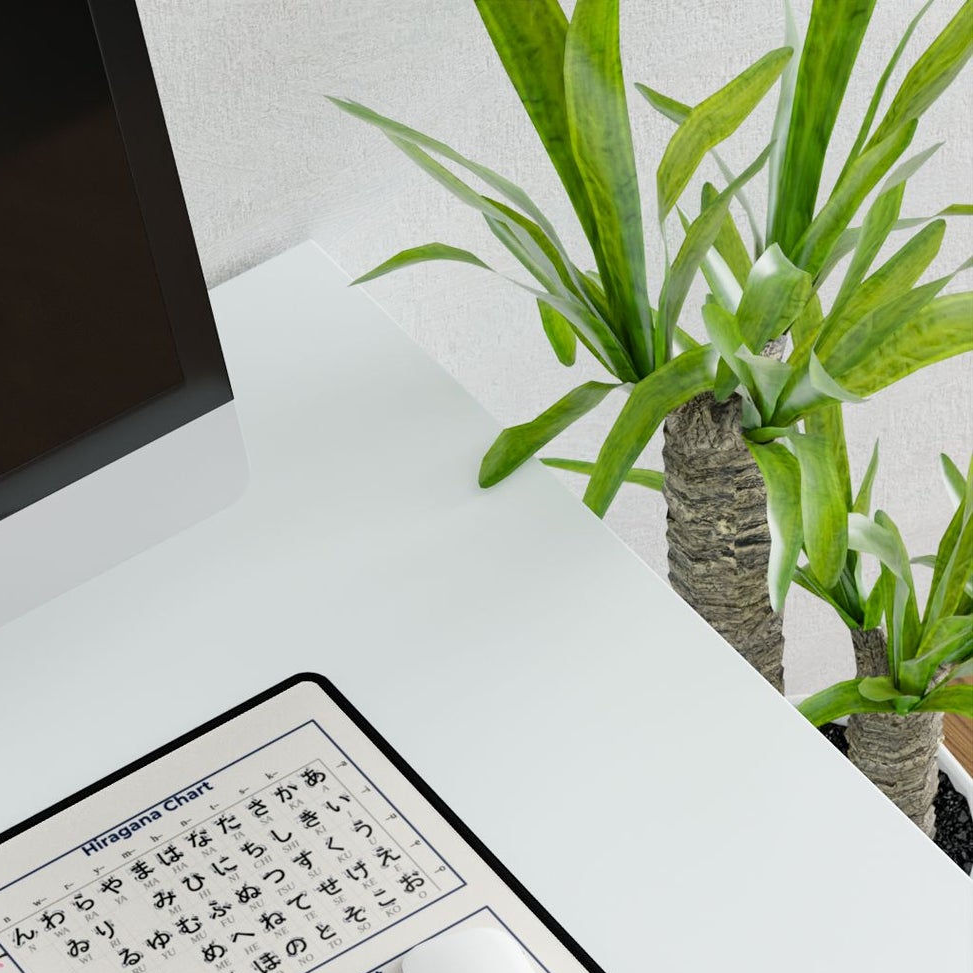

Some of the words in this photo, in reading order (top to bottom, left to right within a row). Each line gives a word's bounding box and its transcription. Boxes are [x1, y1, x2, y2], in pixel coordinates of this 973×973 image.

[15, 927, 35, 946] ん
[40, 912, 65, 929] わ
[74, 895, 95, 911] ら
[101, 876, 123, 894] や
[130, 861, 155, 880] ま
[156, 844, 184, 867] は
[187, 830, 213, 848] な
[216, 815, 242, 835] た
[248, 799, 269, 818] さ
[274, 785, 298, 803] か
[300, 769, 326, 787] あ
[81, 810, 162, 856] Hiragana
[163, 781, 214, 812] Chart
[95, 920, 115, 940] り
[152, 891, 177, 909] み
[181, 873, 206, 892] ひ
[211, 856, 238, 876] に
[241, 842, 265, 859] ち
[270, 830, 292, 843] し
[300, 810, 320, 828] き
[326, 795, 351, 813] い
[118, 948, 141, 966] る
[146, 932, 171, 950] ゆ
[176, 916, 201, 934] む
[208, 901, 232, 920] ふ
[234, 886, 262, 904] ぬ
[262, 869, 286, 884] つ
[292, 851, 313, 870] す
[327, 836, 345, 851] く
[353, 820, 373, 838] う
[201, 943, 226, 962] め
[232, 932, 255, 943] へ
[260, 912, 287, 930] ね
[286, 893, 311, 910] て
[319, 879, 342, 896] せ
[346, 862, 368, 881] け
[376, 847, 401, 867] え
[285, 937, 307, 956] の
[315, 924, 337, 940] と
[344, 906, 367, 923] そ
[374, 890, 396, 907] こ
[399, 872, 425, 893] お
